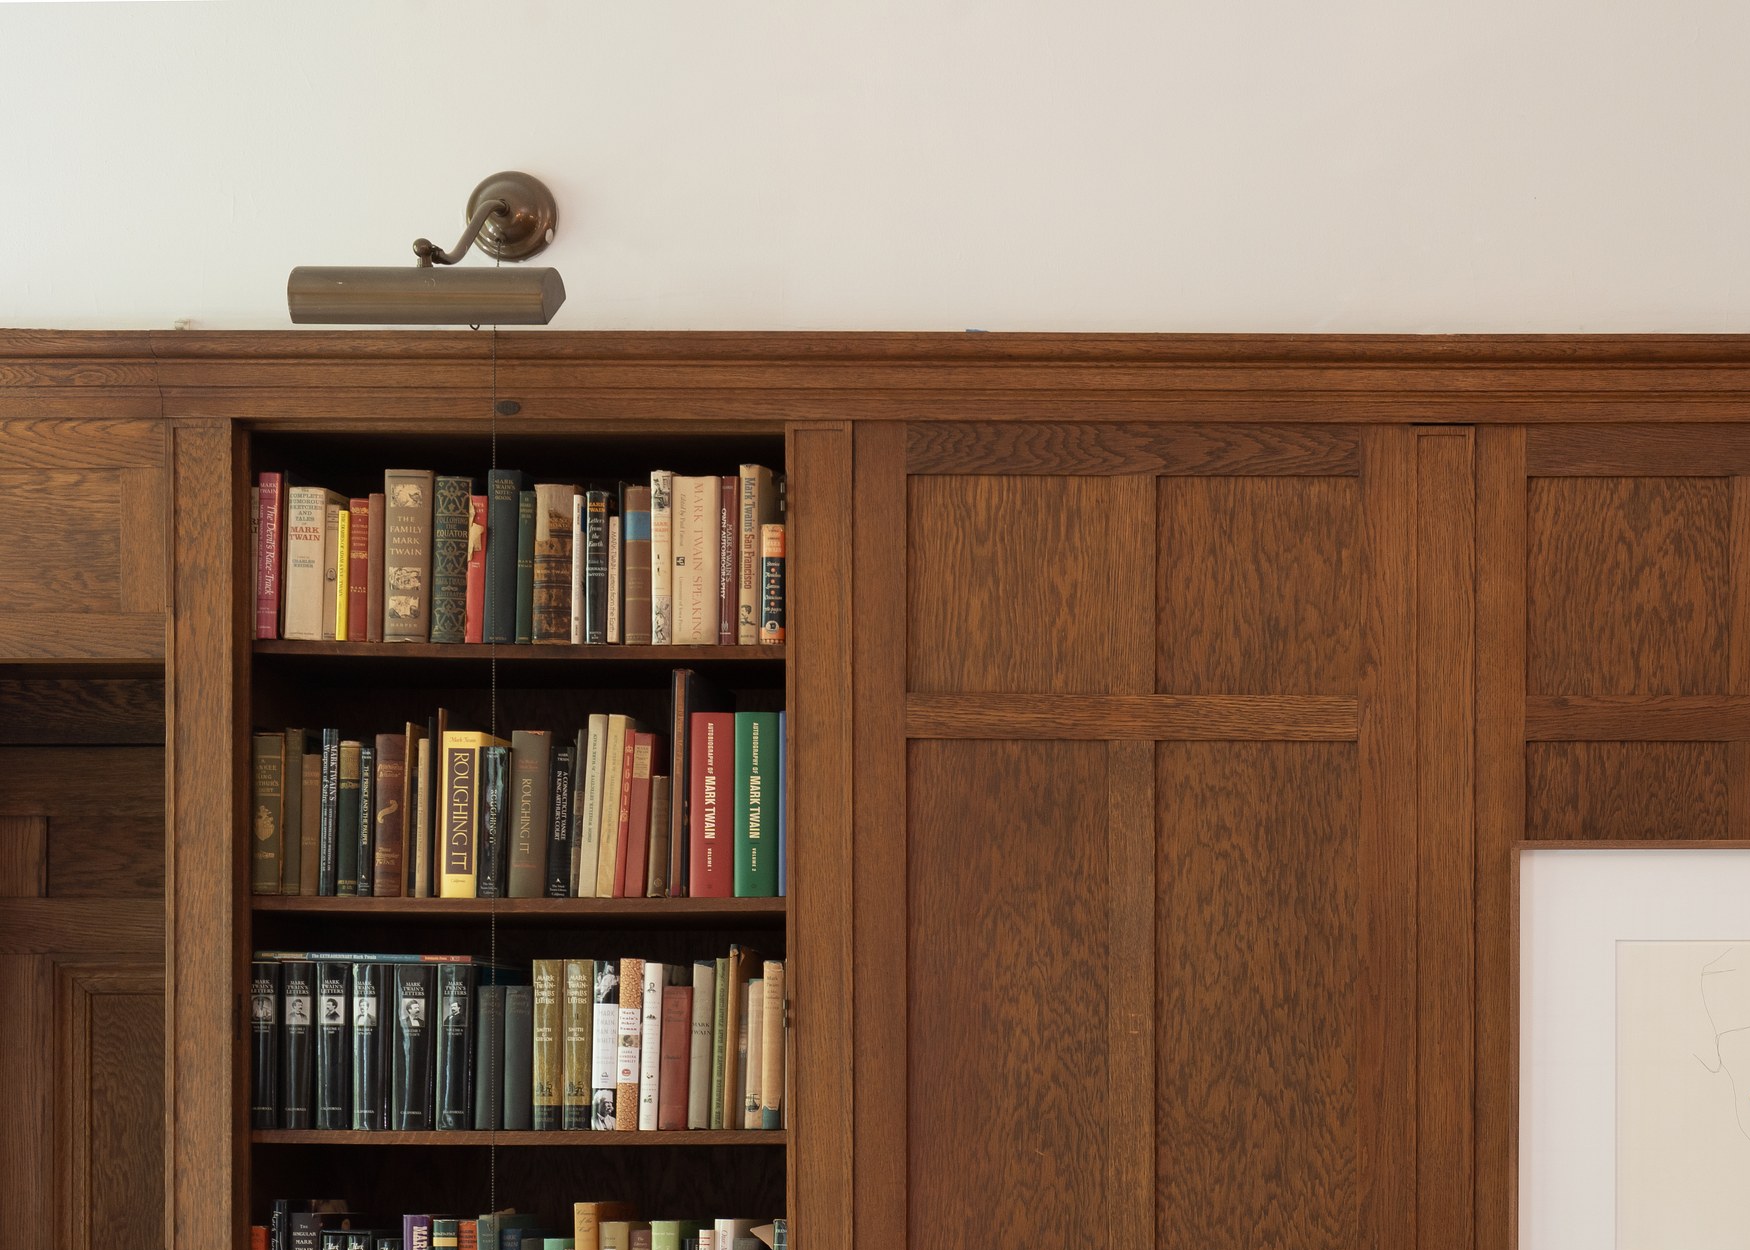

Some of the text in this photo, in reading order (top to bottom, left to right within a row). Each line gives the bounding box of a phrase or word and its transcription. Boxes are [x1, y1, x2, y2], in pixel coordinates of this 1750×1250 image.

[265, 504, 276, 595] The Devil's Race-Track
[692, 483, 703, 640] MARK TWAIN SPEAKING
[744, 478, 755, 589] Mark Twain's San Francisco
[451, 752, 469, 870] ROUGHING IT
[705, 776, 715, 805] MARK
[750, 776, 761, 805] MARK
[704, 807, 715, 839] TWAIN
[749, 807, 760, 838] TWAIN
